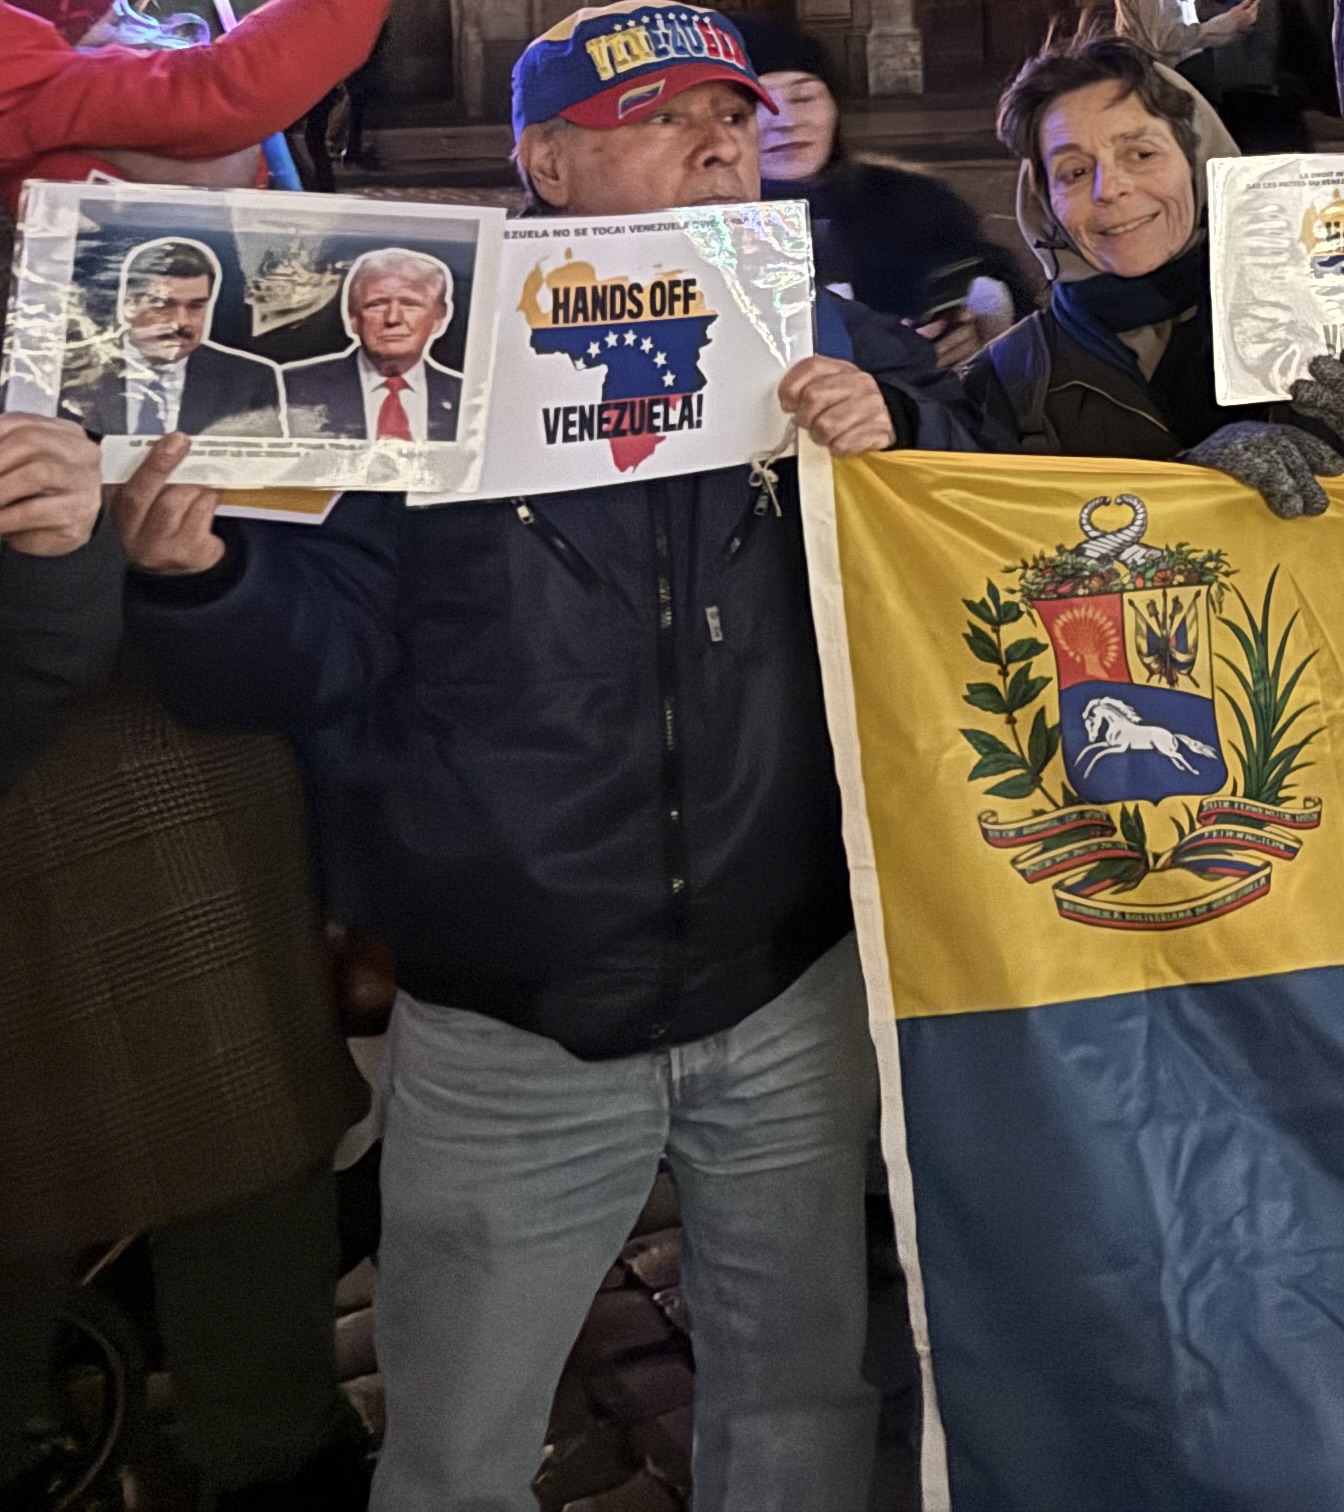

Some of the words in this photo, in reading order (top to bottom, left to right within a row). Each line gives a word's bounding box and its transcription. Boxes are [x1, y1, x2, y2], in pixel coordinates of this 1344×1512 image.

[551, 283, 645, 325] HANDS
[650, 278, 697, 317] OFF
[542, 393, 704, 445] VENEZUELA!
